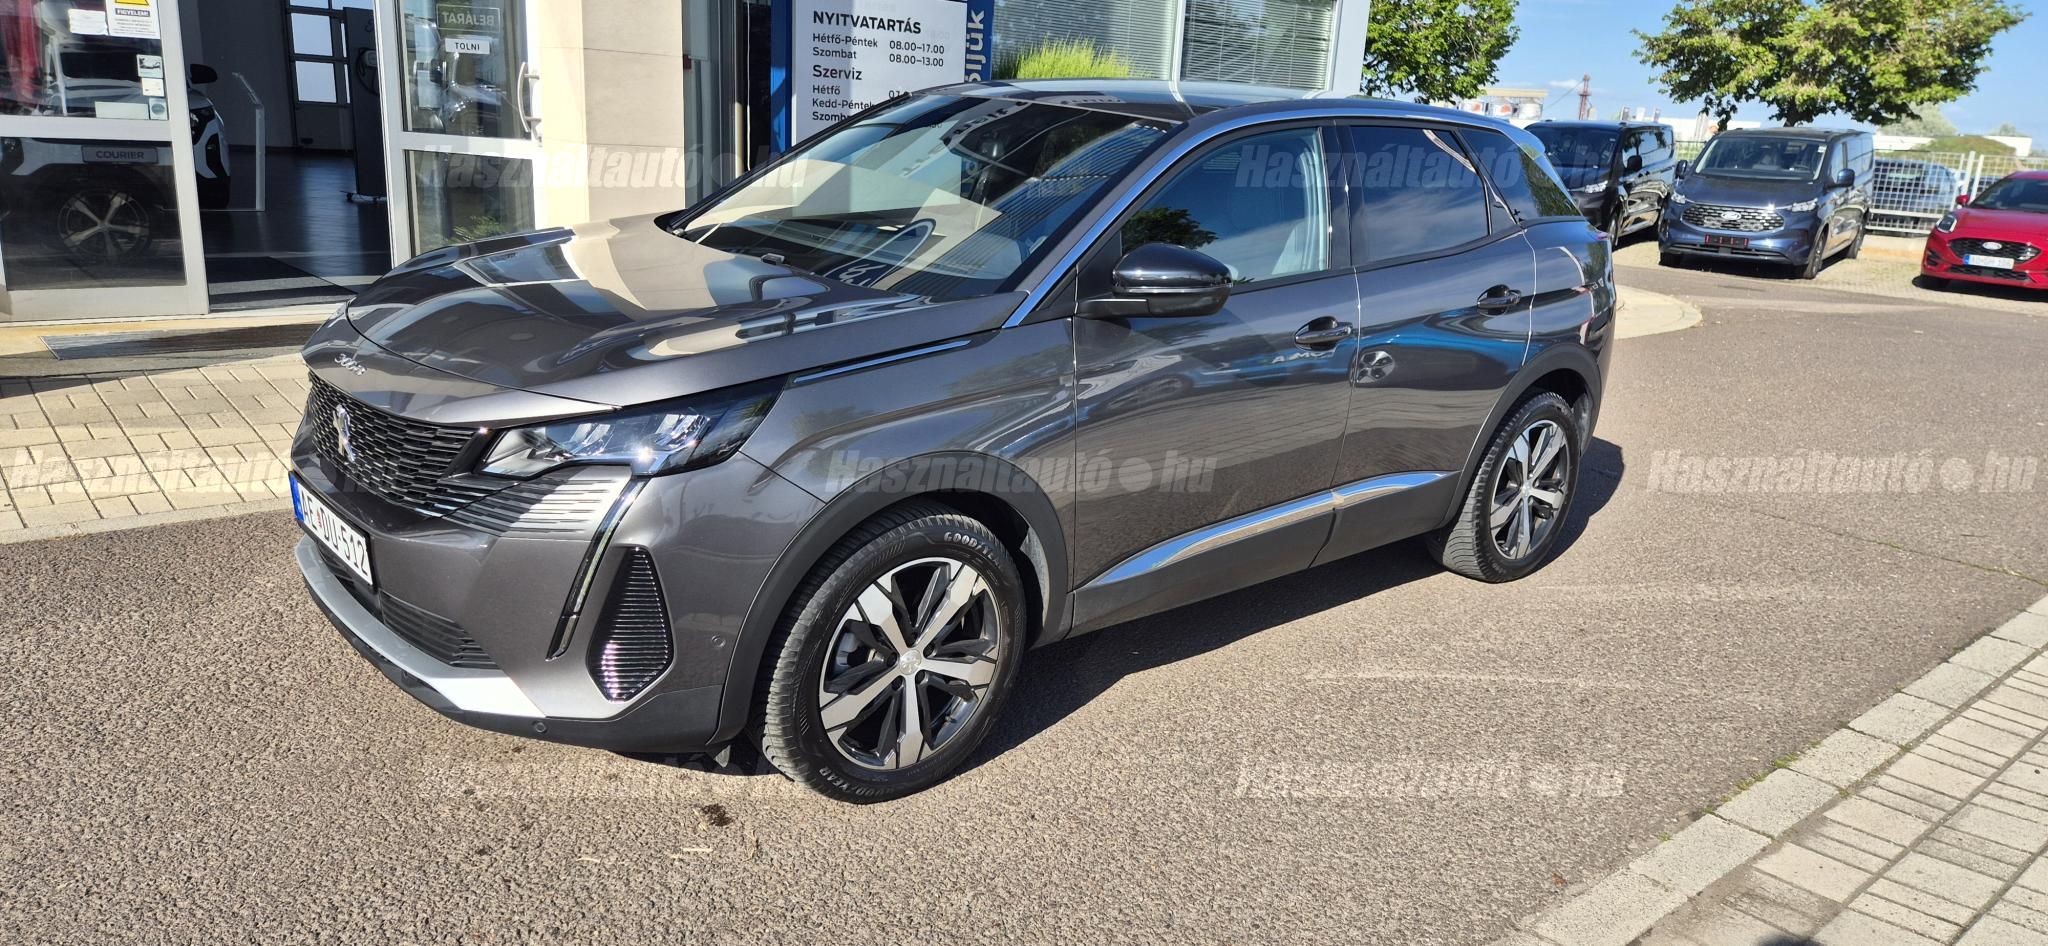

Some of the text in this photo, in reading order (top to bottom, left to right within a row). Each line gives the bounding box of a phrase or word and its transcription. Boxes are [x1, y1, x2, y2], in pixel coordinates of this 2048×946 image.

[813, 11, 921, 34] NYITVATARTÁS
[455, 42, 480, 51] TOLNI
[812, 33, 878, 48] Hétfő-Péntek
[812, 47, 857, 59] Szombat
[812, 64, 863, 80] Szerviz
[812, 85, 841, 95] Hétfő
[95, 150, 144, 160] COURIER
